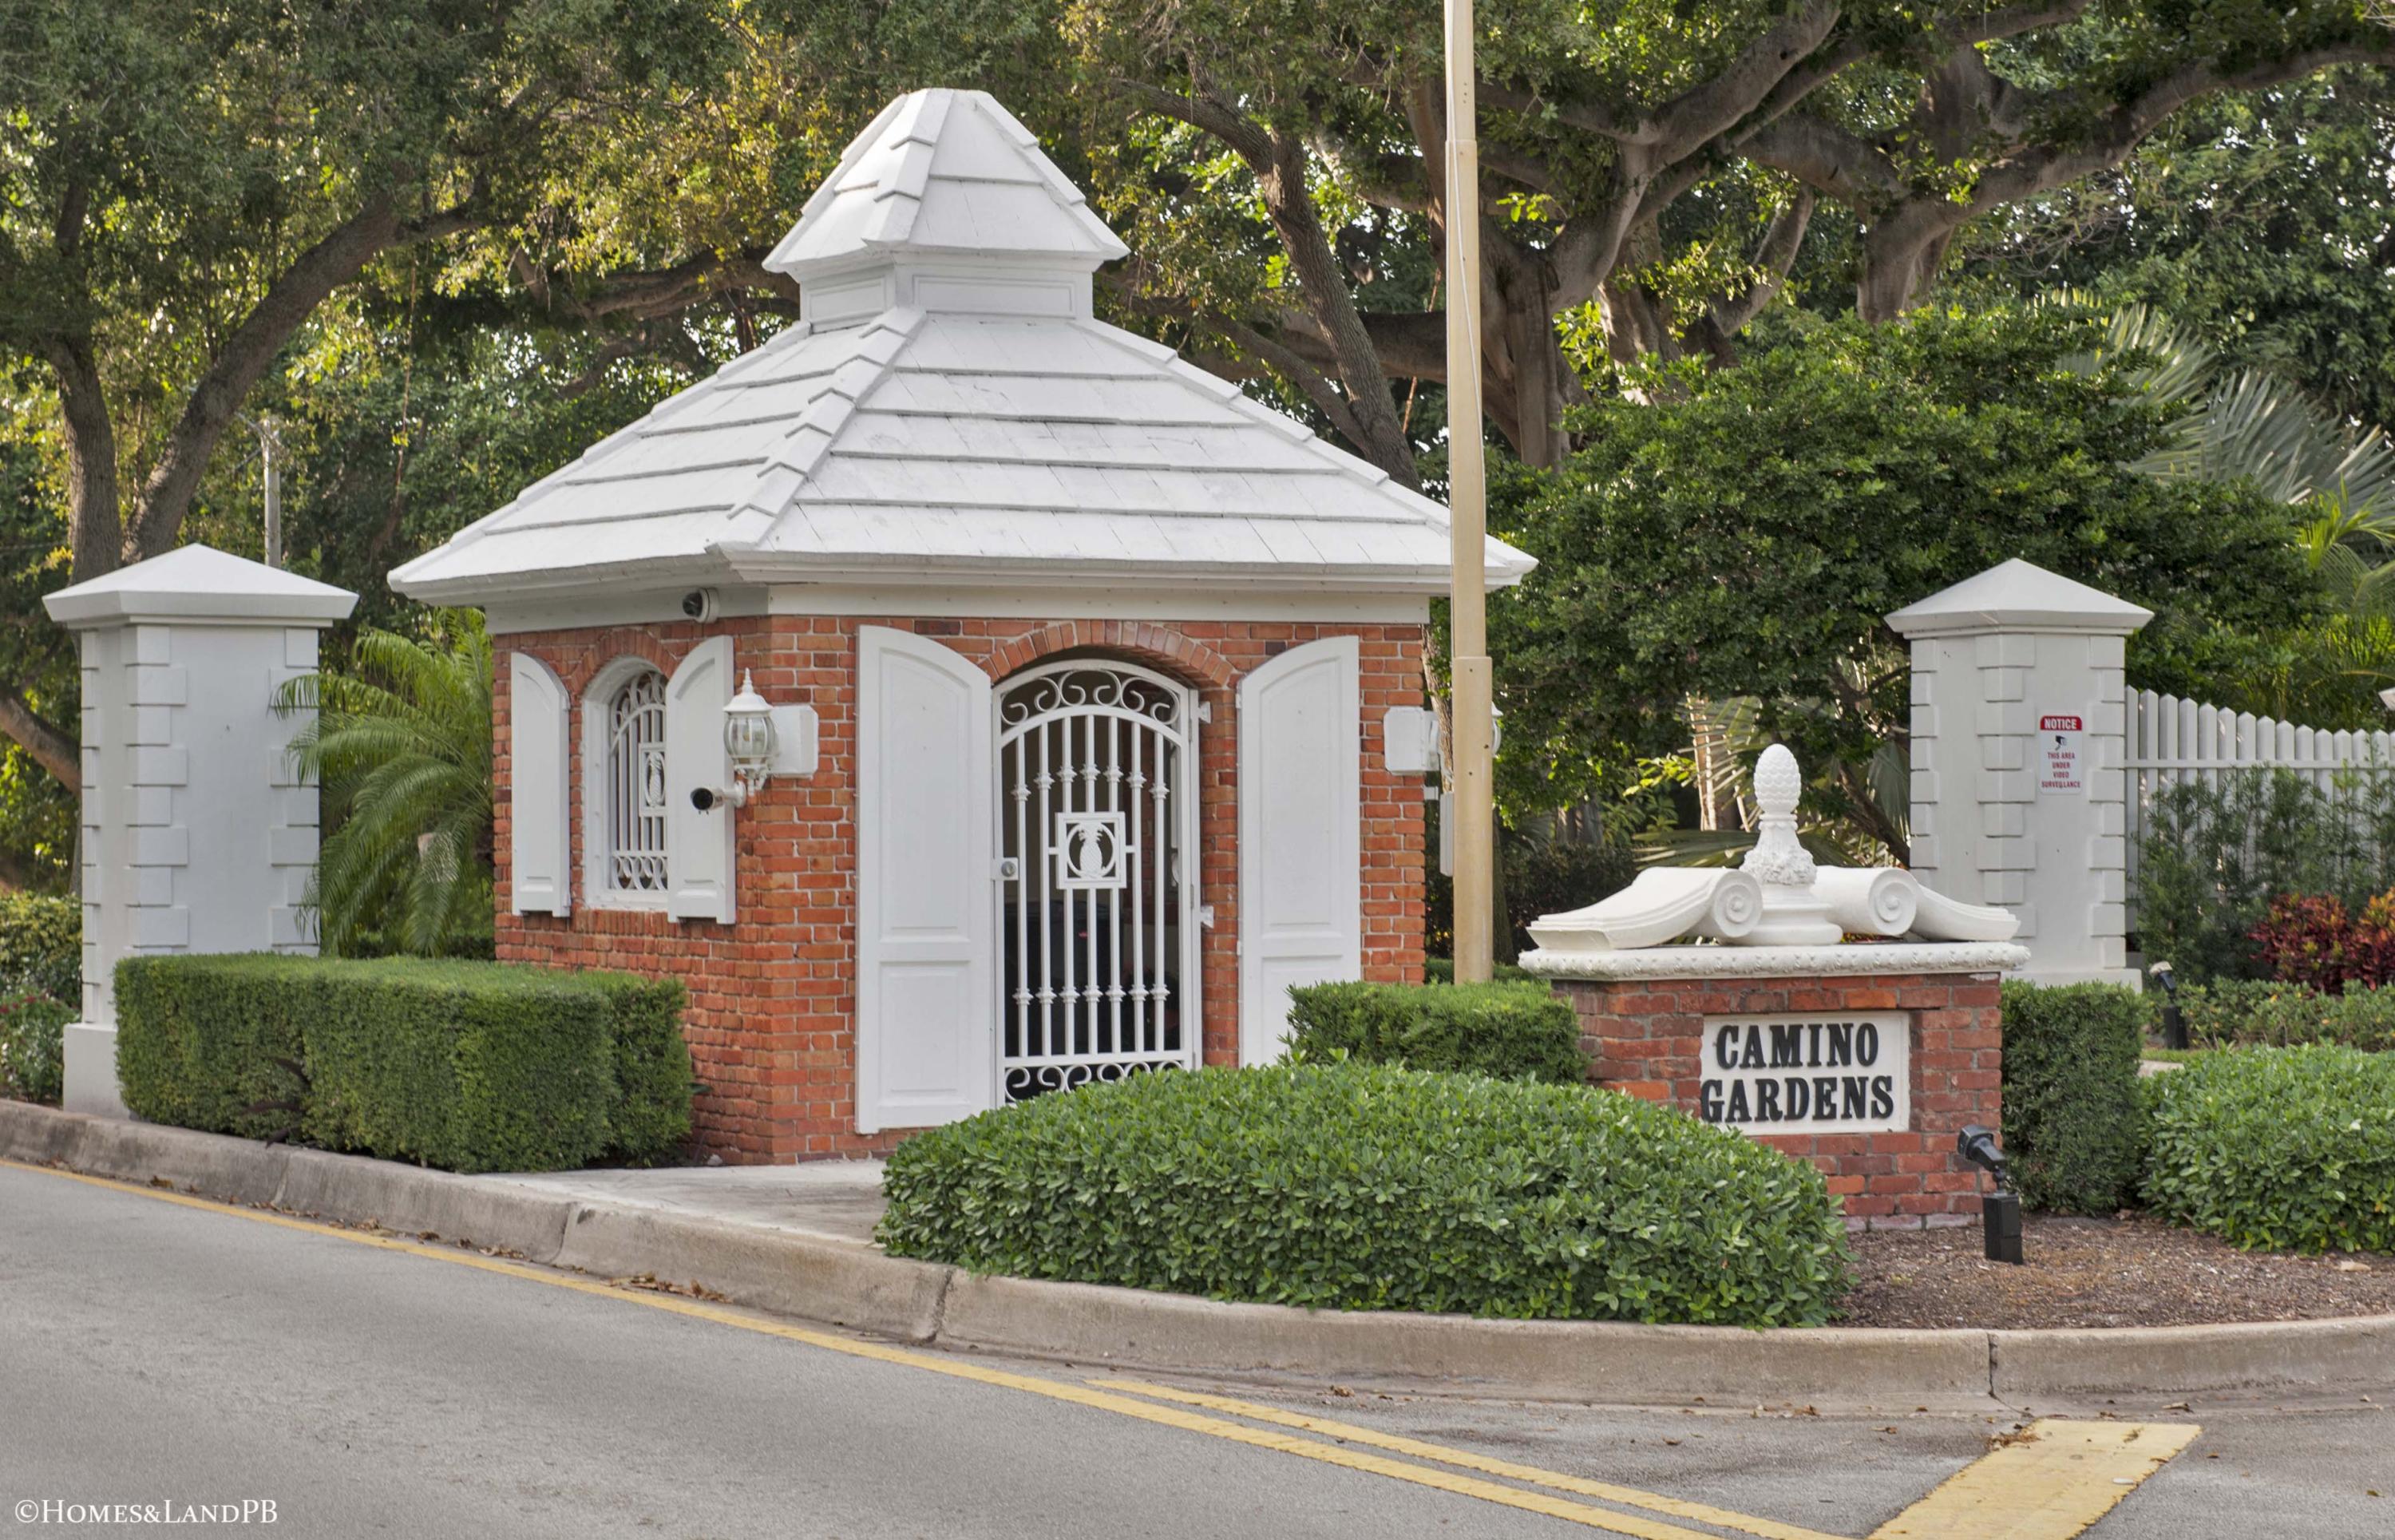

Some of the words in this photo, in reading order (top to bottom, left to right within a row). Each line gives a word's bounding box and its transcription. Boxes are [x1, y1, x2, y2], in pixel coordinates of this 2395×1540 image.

[2045, 719, 2076, 729] NOTICE
[1716, 1023, 1878, 1070] CAMINO
[1700, 1075, 1894, 1123] GARDENS
